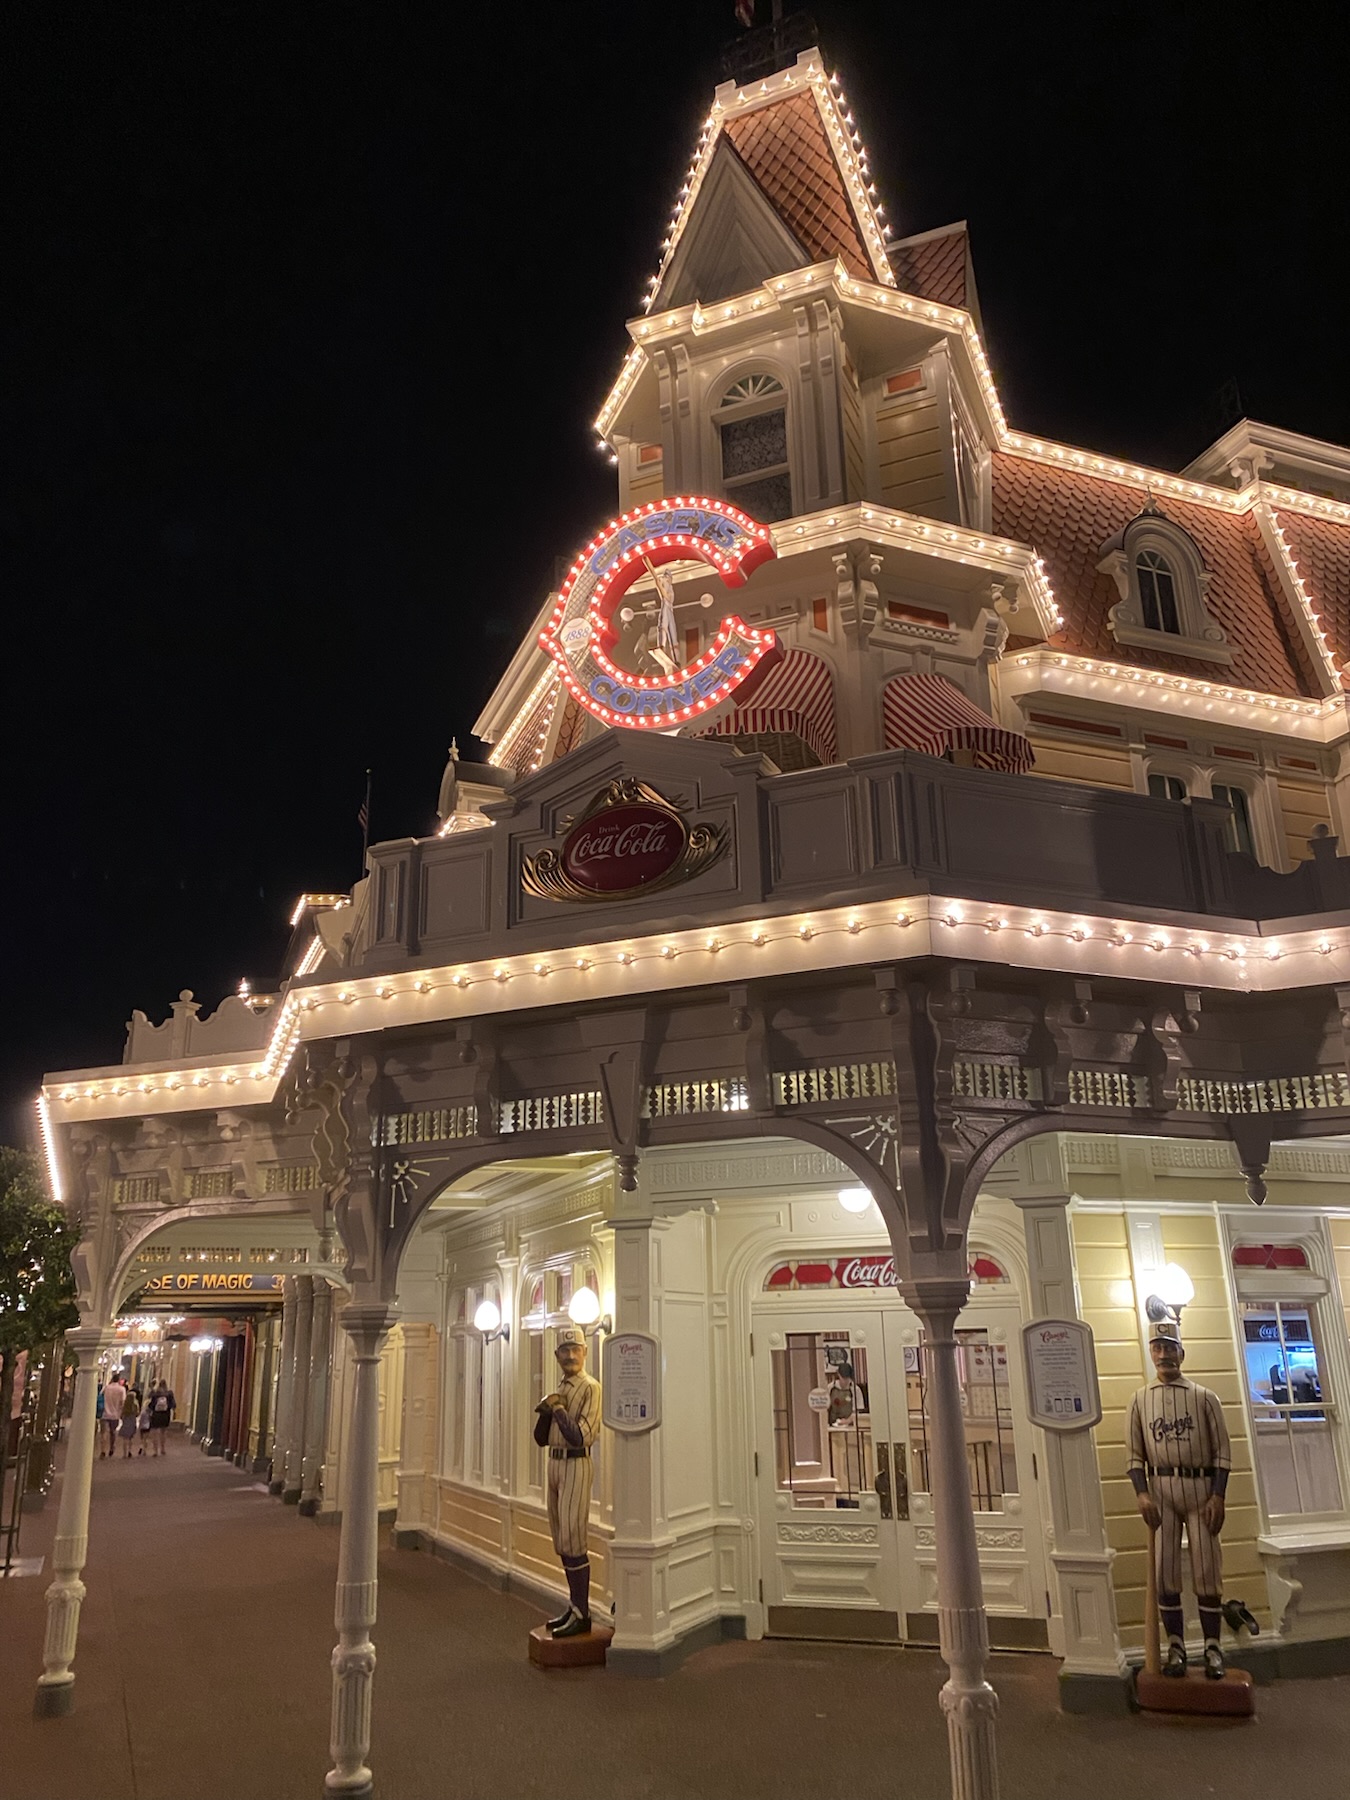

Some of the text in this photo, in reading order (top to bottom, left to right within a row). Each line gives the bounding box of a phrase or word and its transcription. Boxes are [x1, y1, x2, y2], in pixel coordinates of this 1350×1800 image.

[591, 510, 741, 576] CASEY'S
[563, 626, 590, 642] 1888
[589, 646, 748, 715] CORNER
[570, 821, 670, 866] Coca-Cola
[177, 1274, 199, 1289] OF
[202, 1273, 253, 1289] MAGIC
[565, 1332, 574, 1340] C
[1158, 1324, 1168, 1334] C
[1149, 1411, 1195, 1442] Casey's
